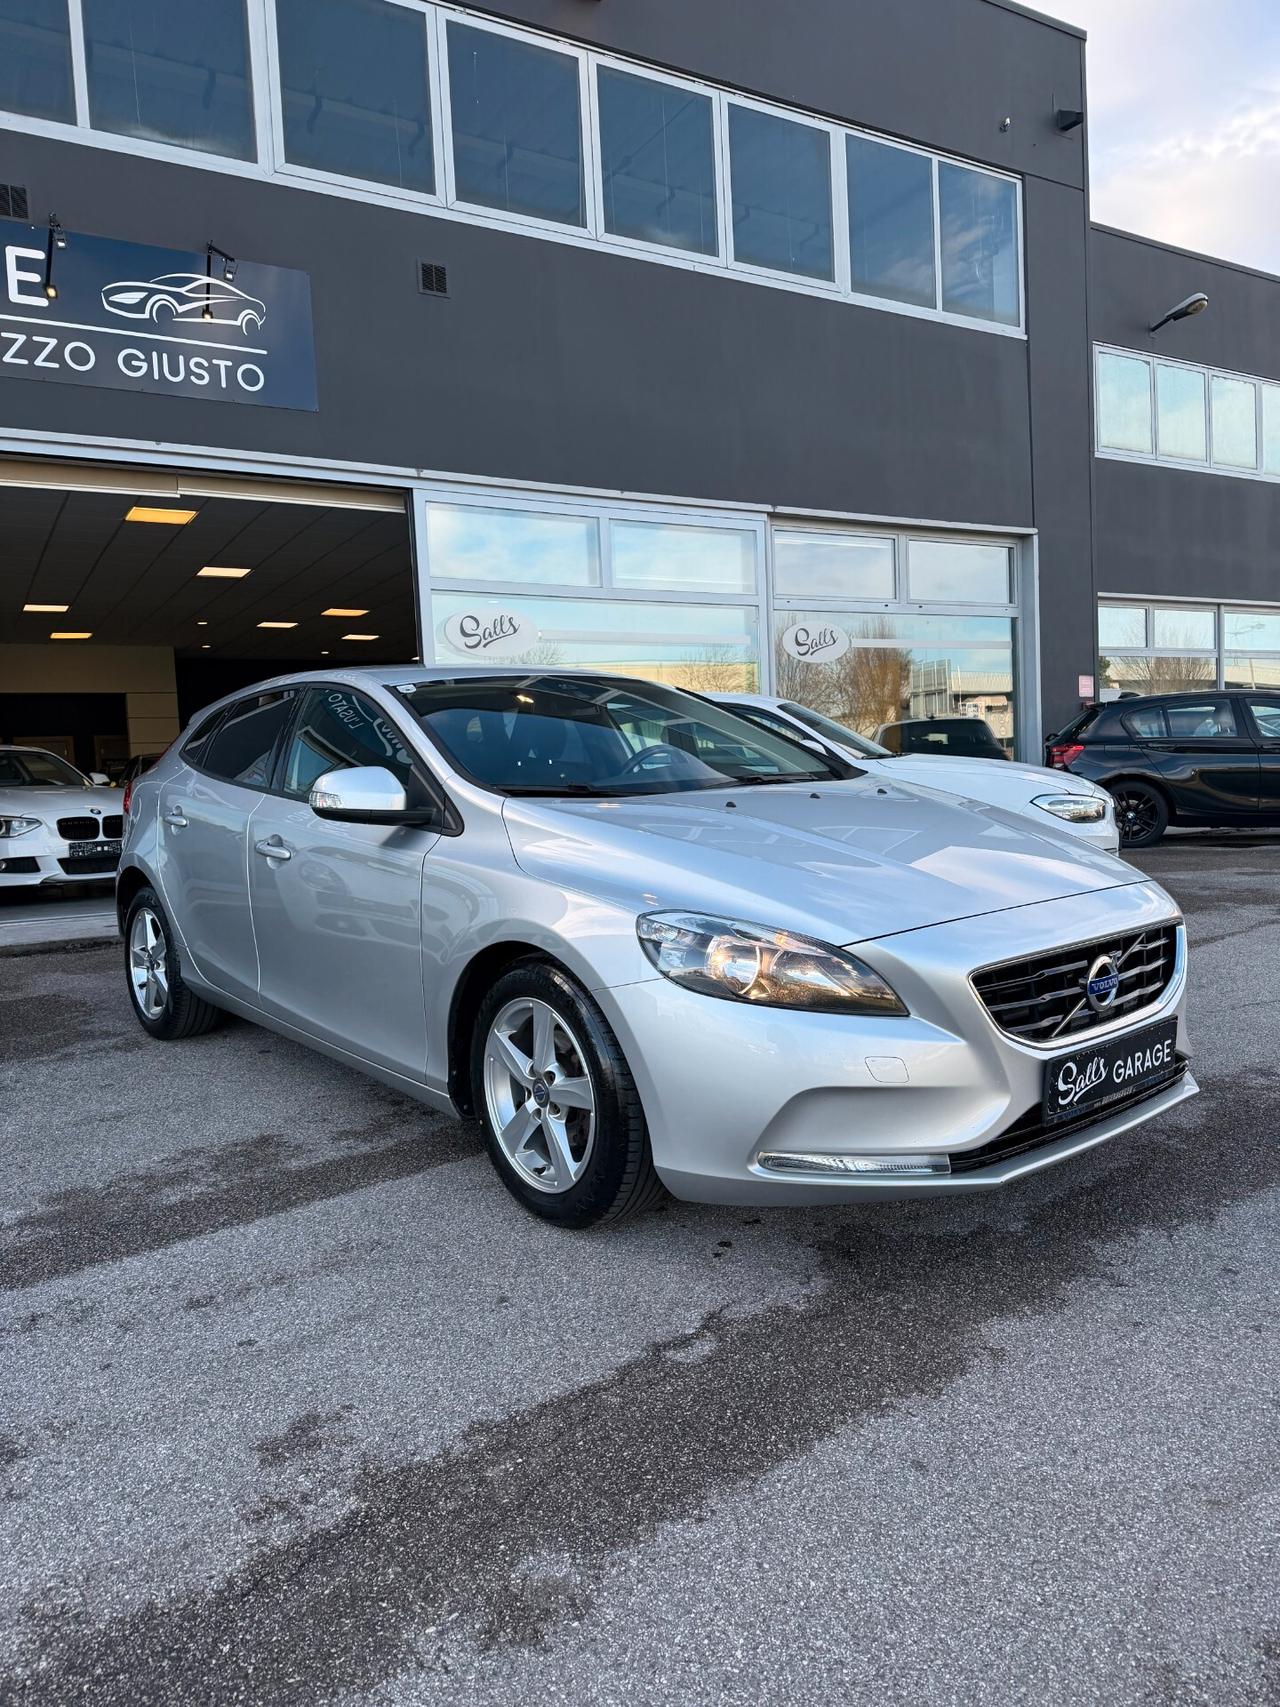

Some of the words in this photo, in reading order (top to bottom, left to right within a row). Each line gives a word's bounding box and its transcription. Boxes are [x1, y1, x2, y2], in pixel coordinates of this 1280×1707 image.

[5, 245, 49, 306] E
[1, 332, 95, 371] ZZO
[117, 348, 265, 391] GIUSTO
[1091, 977, 1118, 991] VOLVO
[1113, 1040, 1172, 1083] GARAGE
